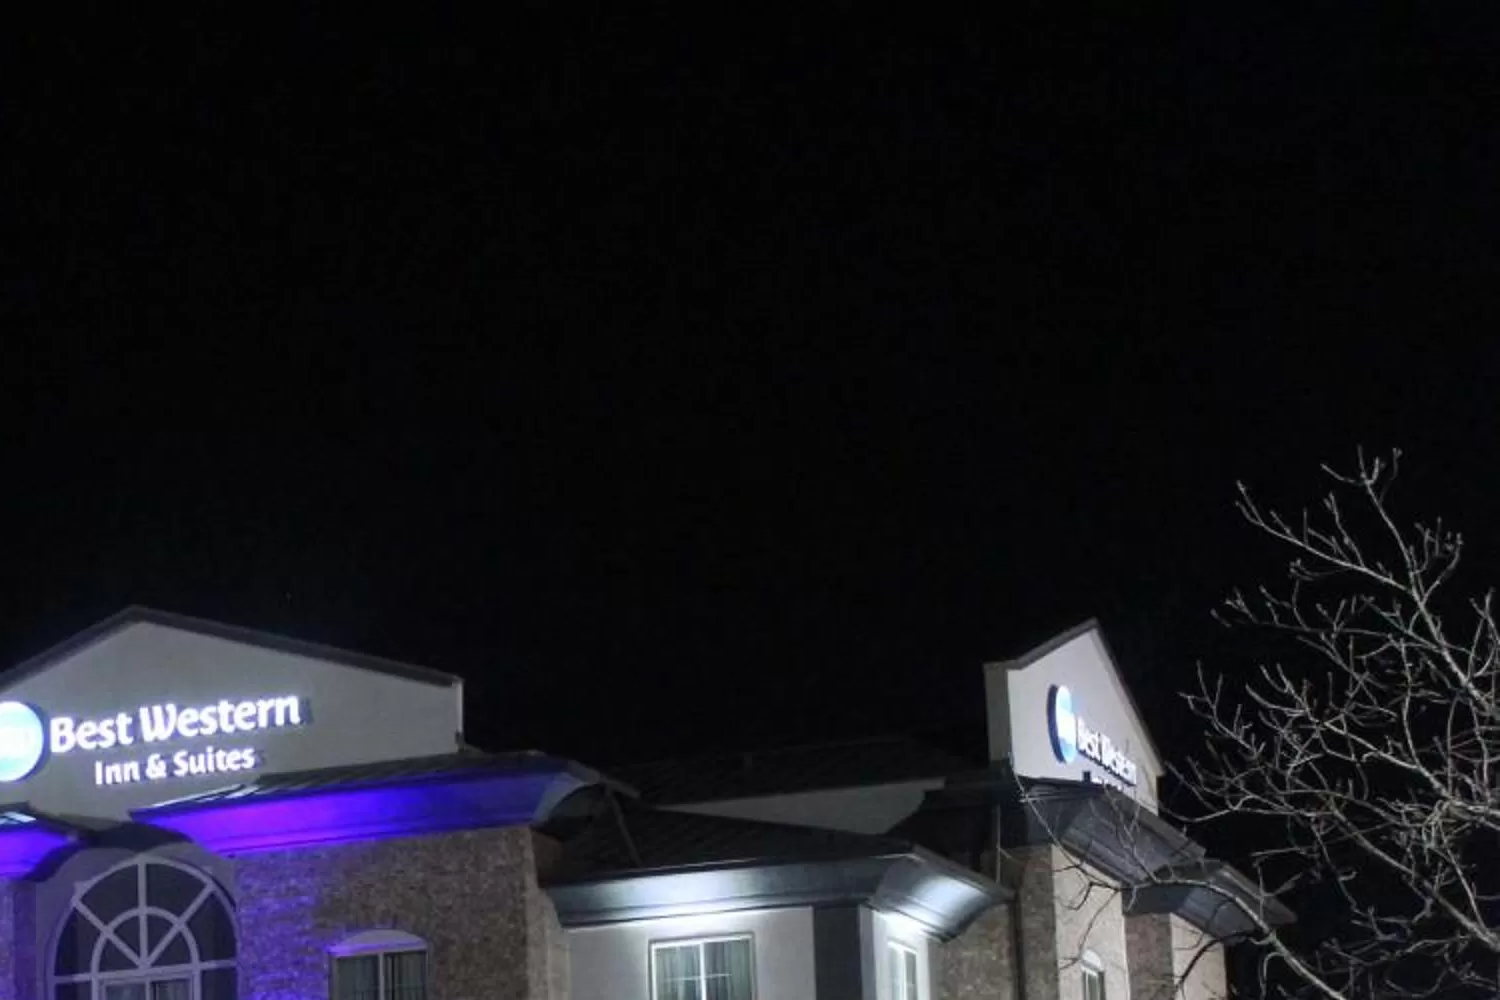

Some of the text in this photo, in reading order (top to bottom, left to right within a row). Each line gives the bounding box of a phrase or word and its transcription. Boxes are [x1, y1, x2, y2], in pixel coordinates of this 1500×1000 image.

[51, 712, 133, 753] Best
[139, 694, 301, 744] Western
[95, 746, 255, 785] Inn & Suites
